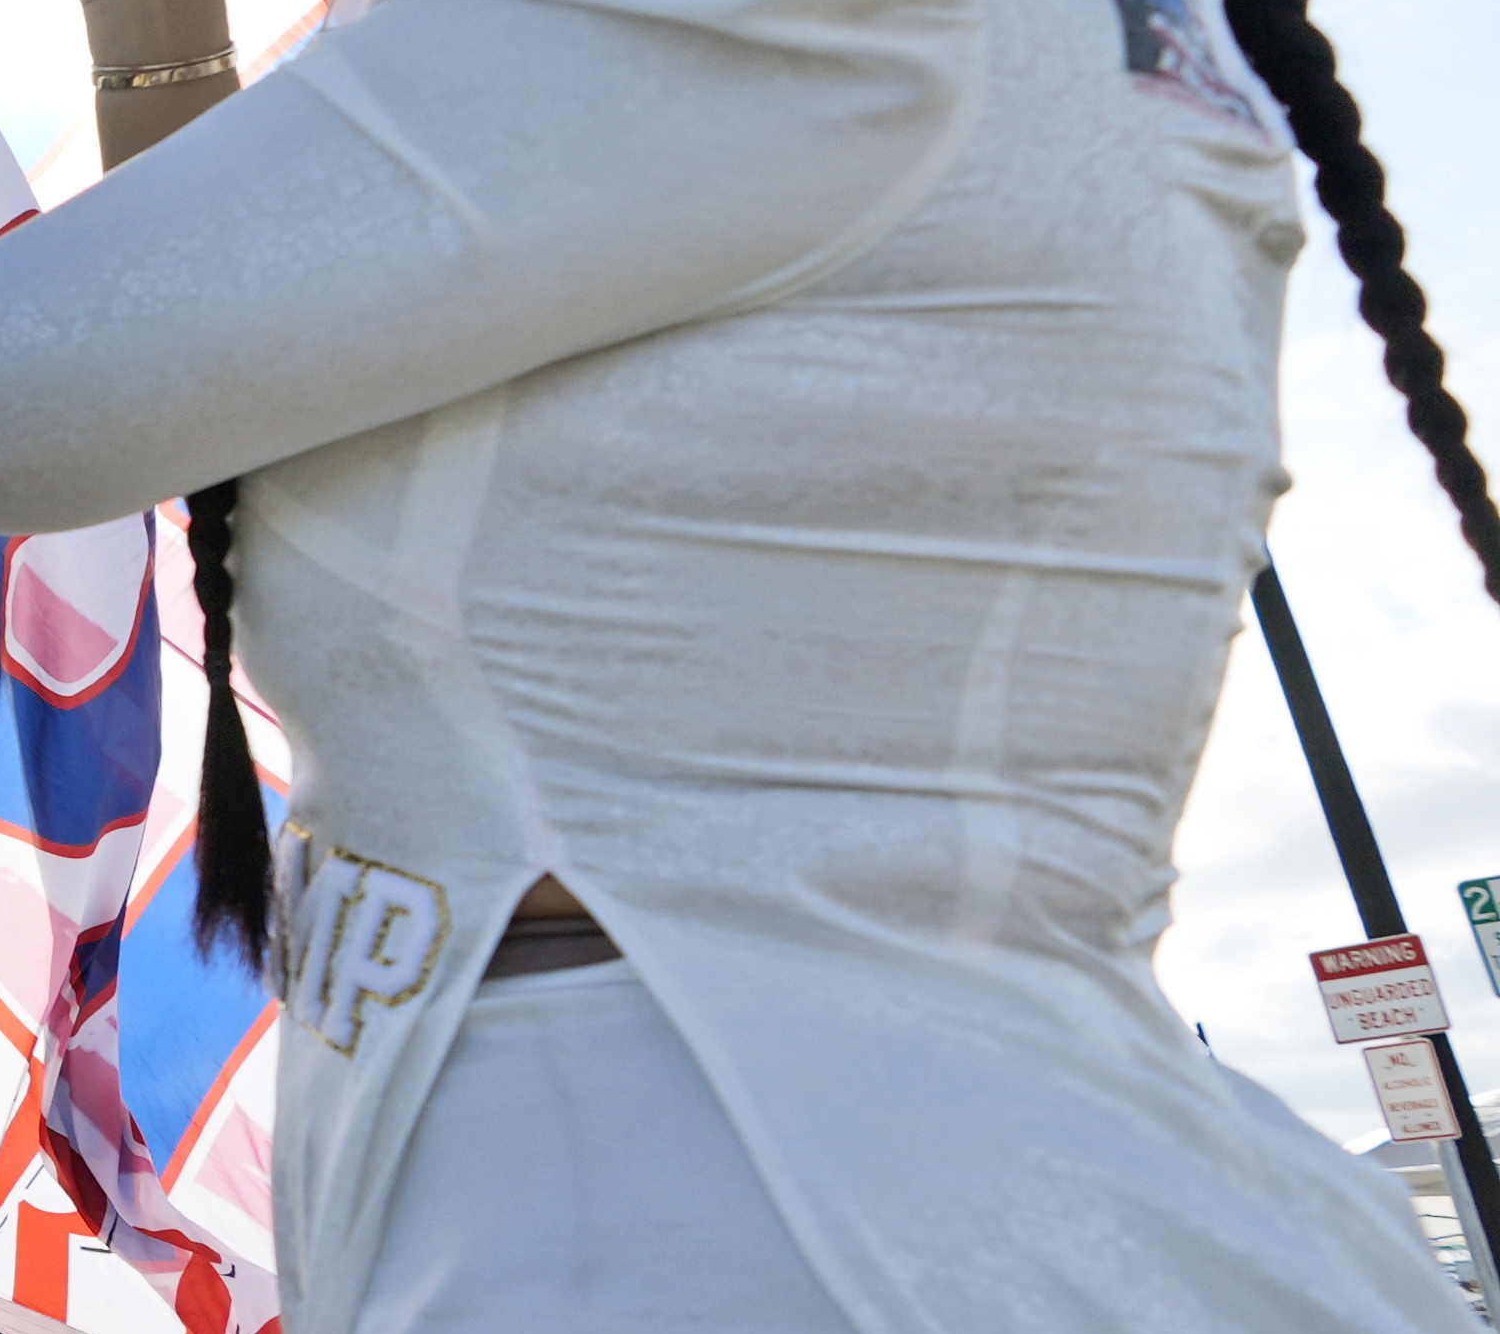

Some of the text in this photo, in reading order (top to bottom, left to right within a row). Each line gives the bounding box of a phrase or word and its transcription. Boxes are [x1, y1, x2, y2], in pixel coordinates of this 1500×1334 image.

[1465, 887, 1497, 921] 2
[1319, 941, 1418, 973] WARNING
[1356, 1006, 1418, 1030] BEACH
